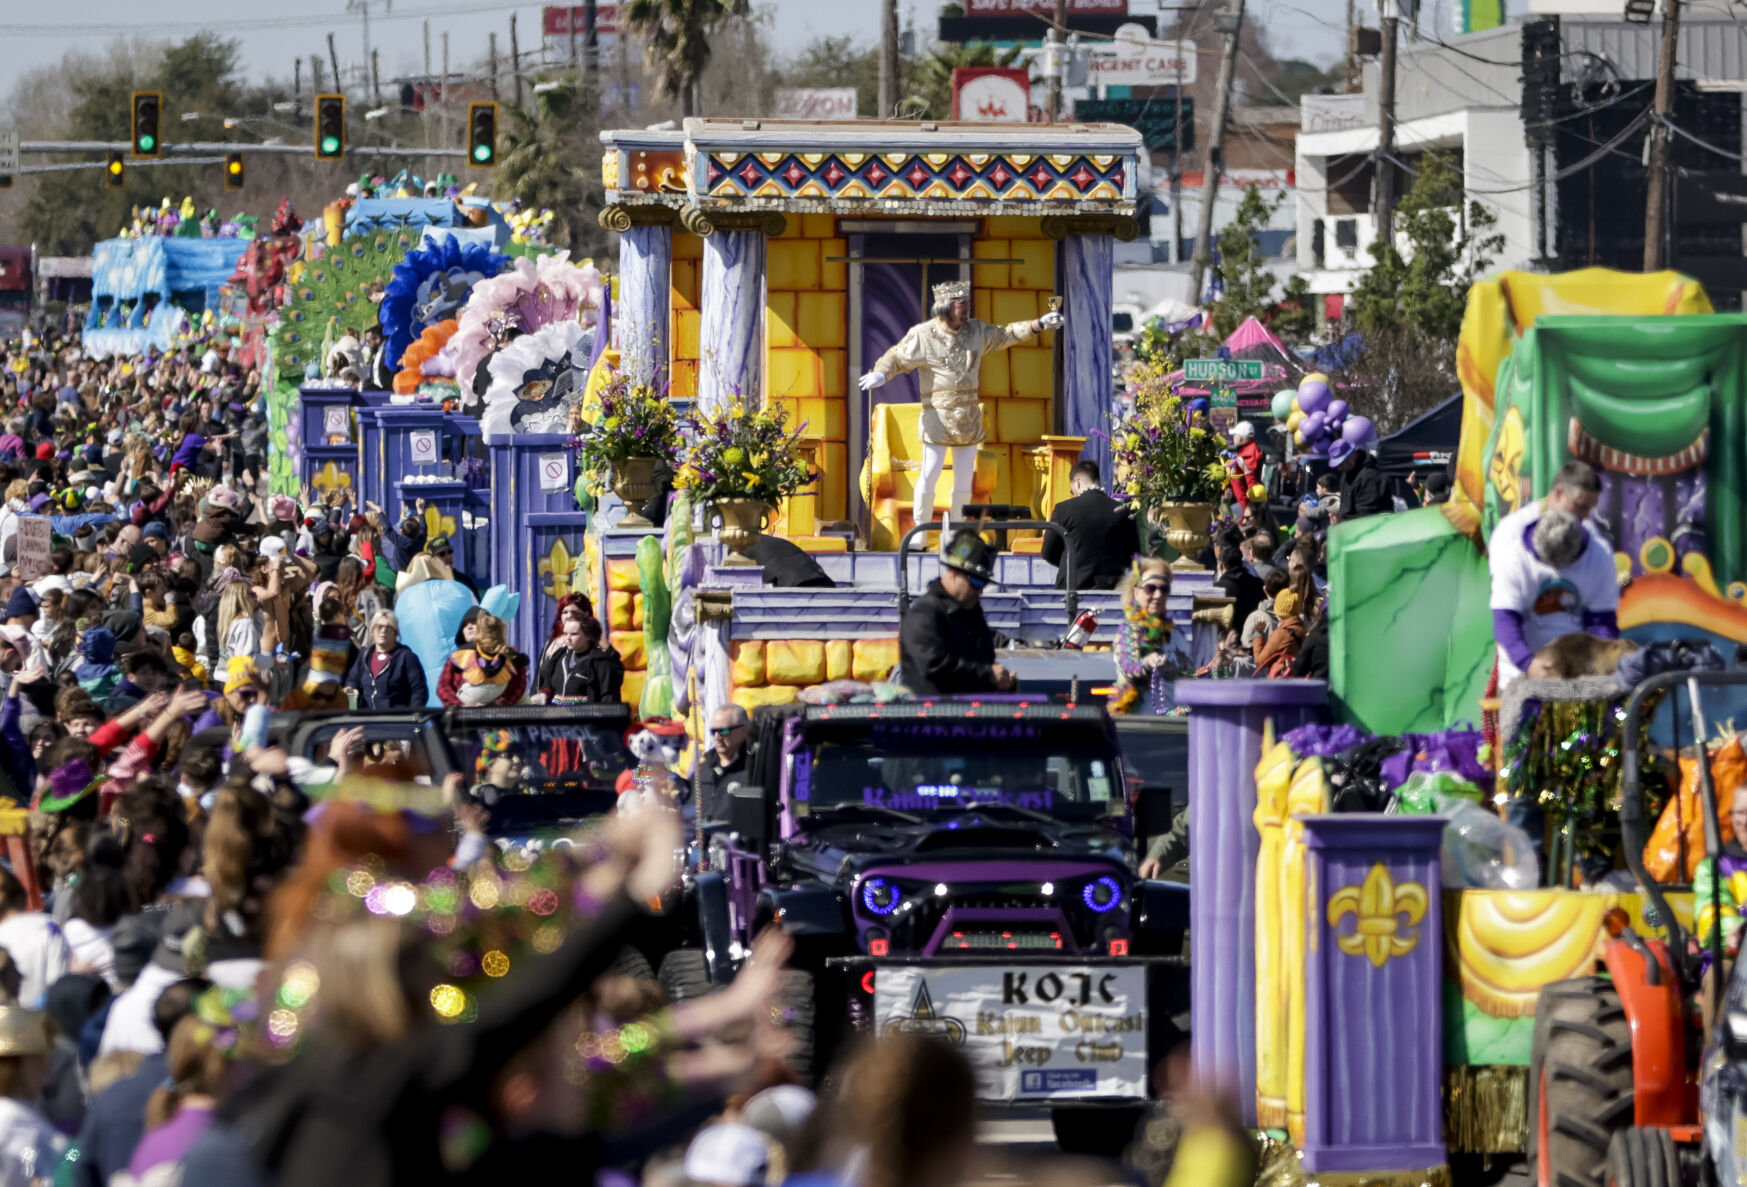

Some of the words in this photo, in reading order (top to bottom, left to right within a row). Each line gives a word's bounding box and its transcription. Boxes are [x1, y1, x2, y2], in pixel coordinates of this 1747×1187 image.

[1188, 362, 1247, 378] HUDSON
[994, 1040, 1053, 1068] Jeep
[1074, 1040, 1123, 1063] Club
